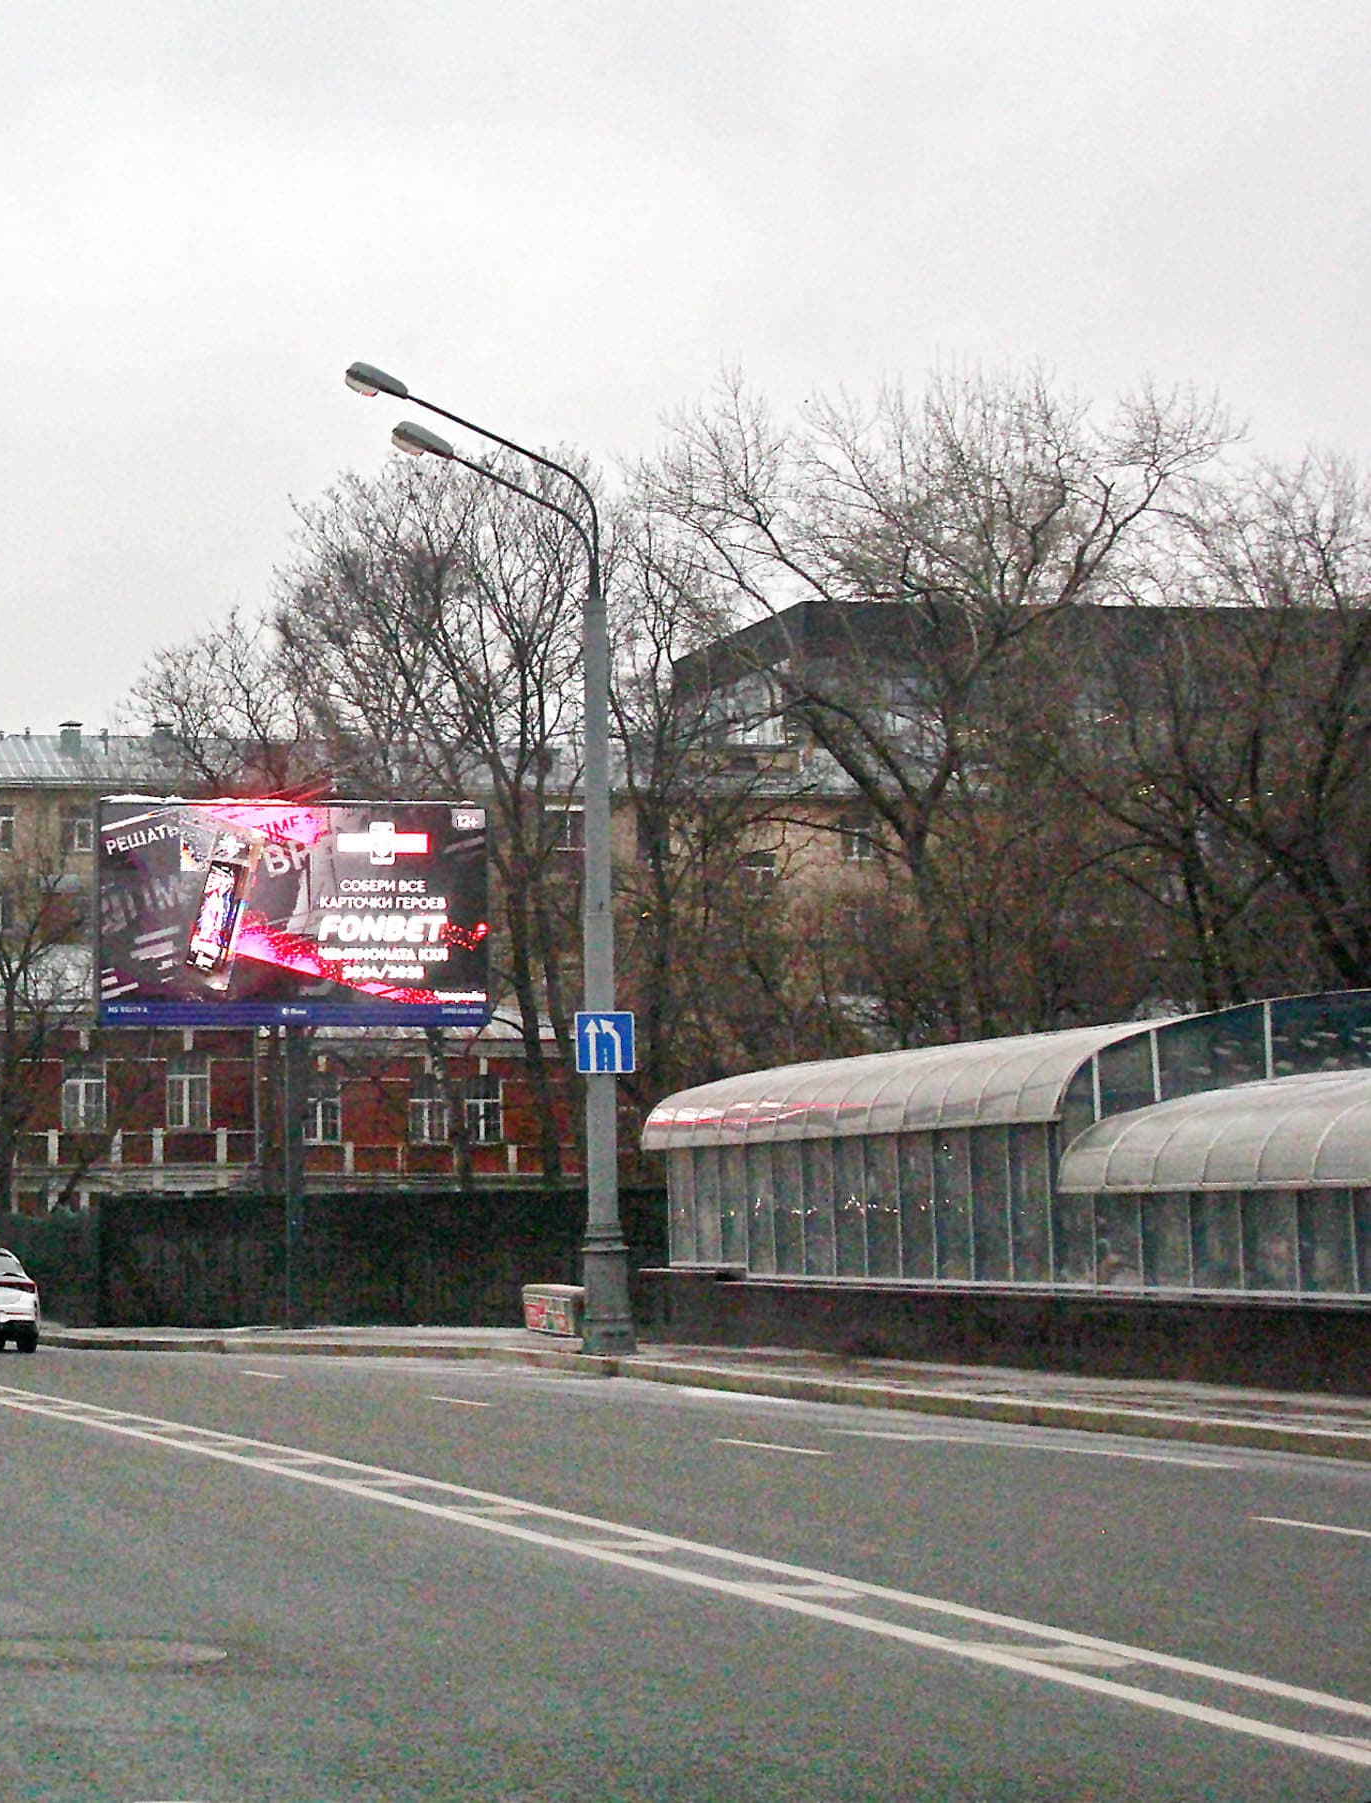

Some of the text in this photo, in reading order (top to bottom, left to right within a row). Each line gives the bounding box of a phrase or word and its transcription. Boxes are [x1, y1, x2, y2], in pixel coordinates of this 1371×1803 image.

[456, 814, 479, 829] 12+
[105, 822, 180, 856] РЕШАТЬ
[339, 879, 427, 893] СОБЕРИ ВСЕ
[319, 896, 448, 910] КАРТОЧКИ ГЕРОЕВ
[317, 914, 448, 943] FONBET
